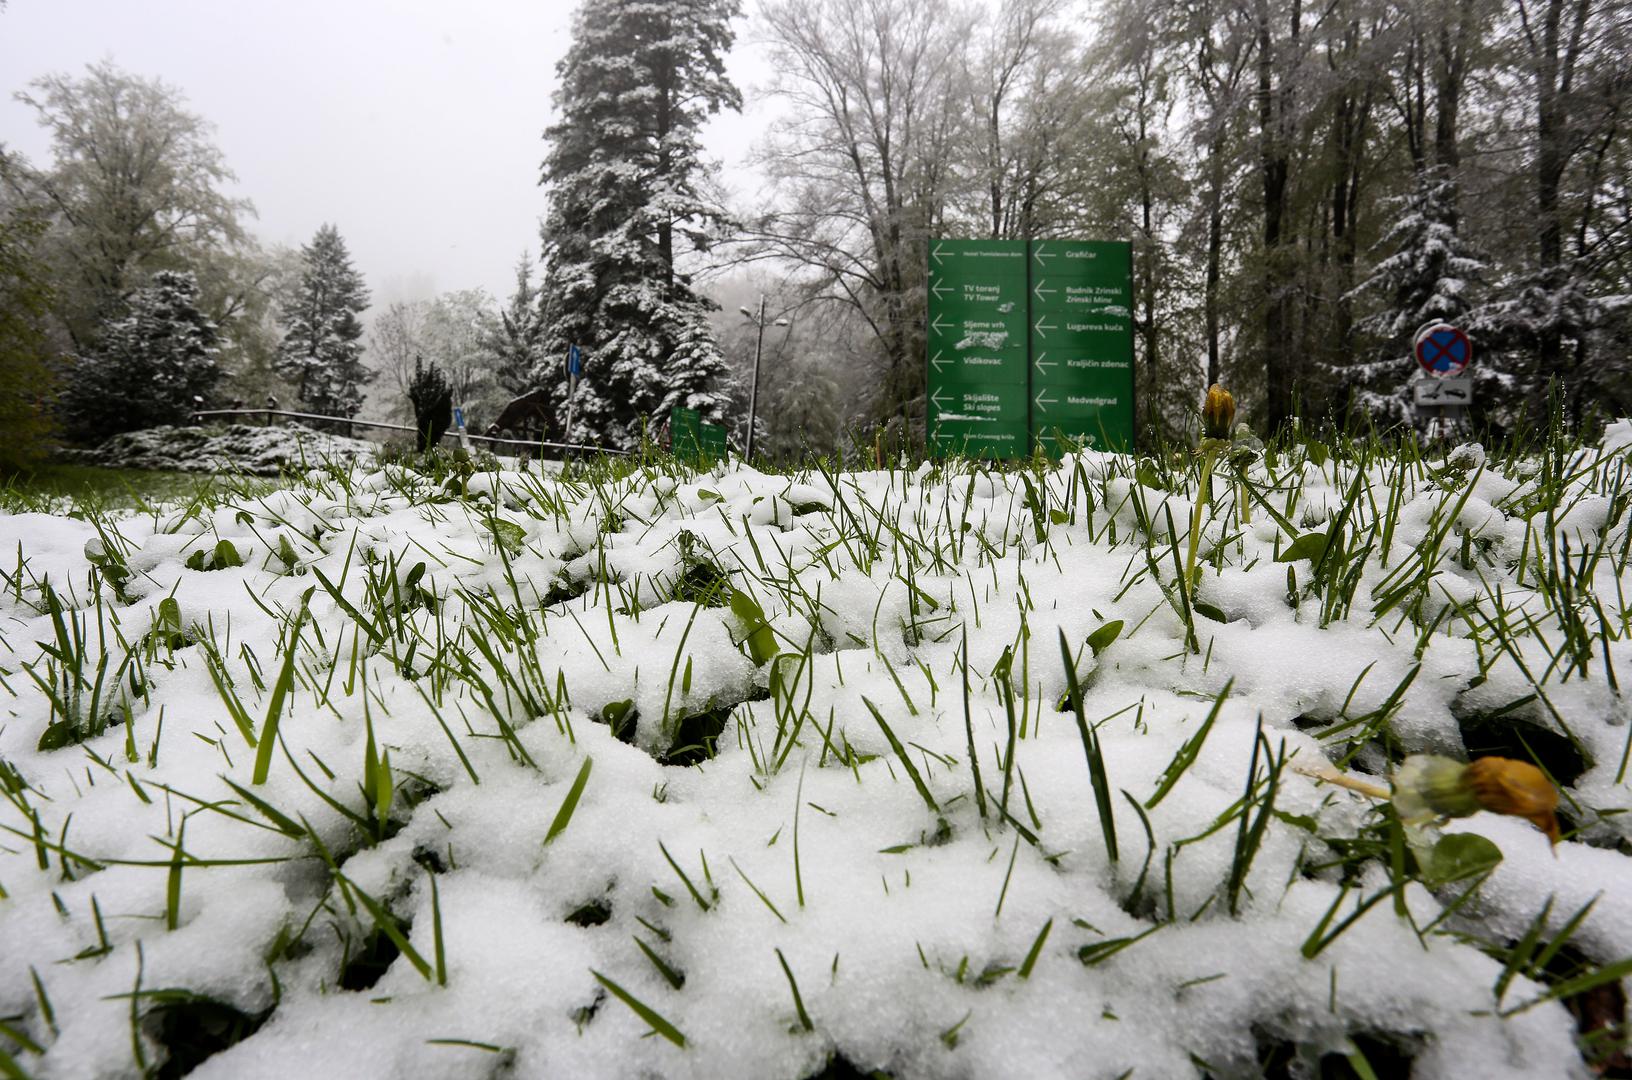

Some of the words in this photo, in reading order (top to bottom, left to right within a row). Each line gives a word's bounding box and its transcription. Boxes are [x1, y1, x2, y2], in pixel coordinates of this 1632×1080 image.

[976, 285, 1000, 294] toranj
[964, 320, 990, 329] Sljeme
[1067, 360, 1100, 368] Kraljičin
[964, 394, 999, 402] Skijalište
[1067, 396, 1118, 406] Medvedgrad
[976, 404, 1000, 412] slopes
